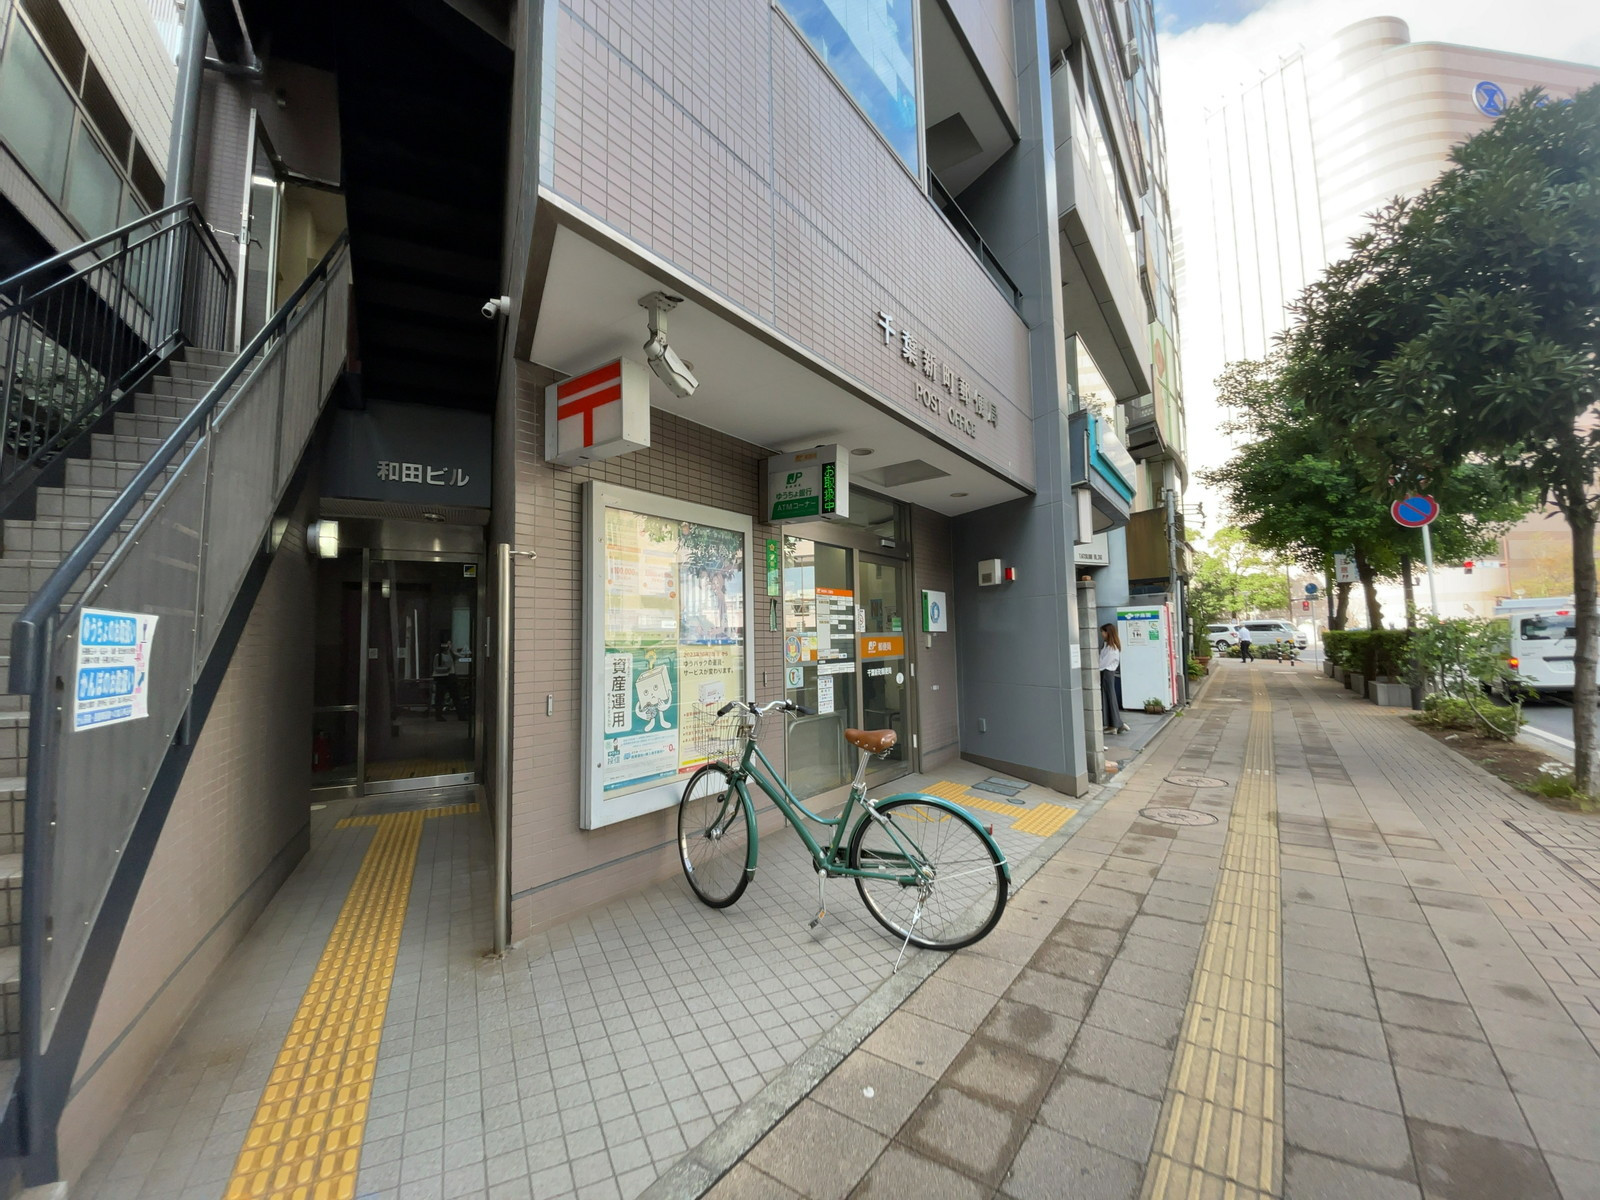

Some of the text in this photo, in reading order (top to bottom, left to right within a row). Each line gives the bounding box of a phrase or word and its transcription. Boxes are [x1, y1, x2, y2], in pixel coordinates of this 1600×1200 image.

[877, 311, 998, 428] 千葉新町郵便局
[915, 382, 976, 440] POST OFFICE
[376, 459, 470, 487] 和田ビル
[823, 464, 836, 512] お取扱中
[775, 487, 813, 500] ゆうちょ銀行
[777, 501, 817, 512] ATMコーナー
[683, 667, 733, 676] サービスが変わります。
[611, 658, 627, 728] 資産運用
